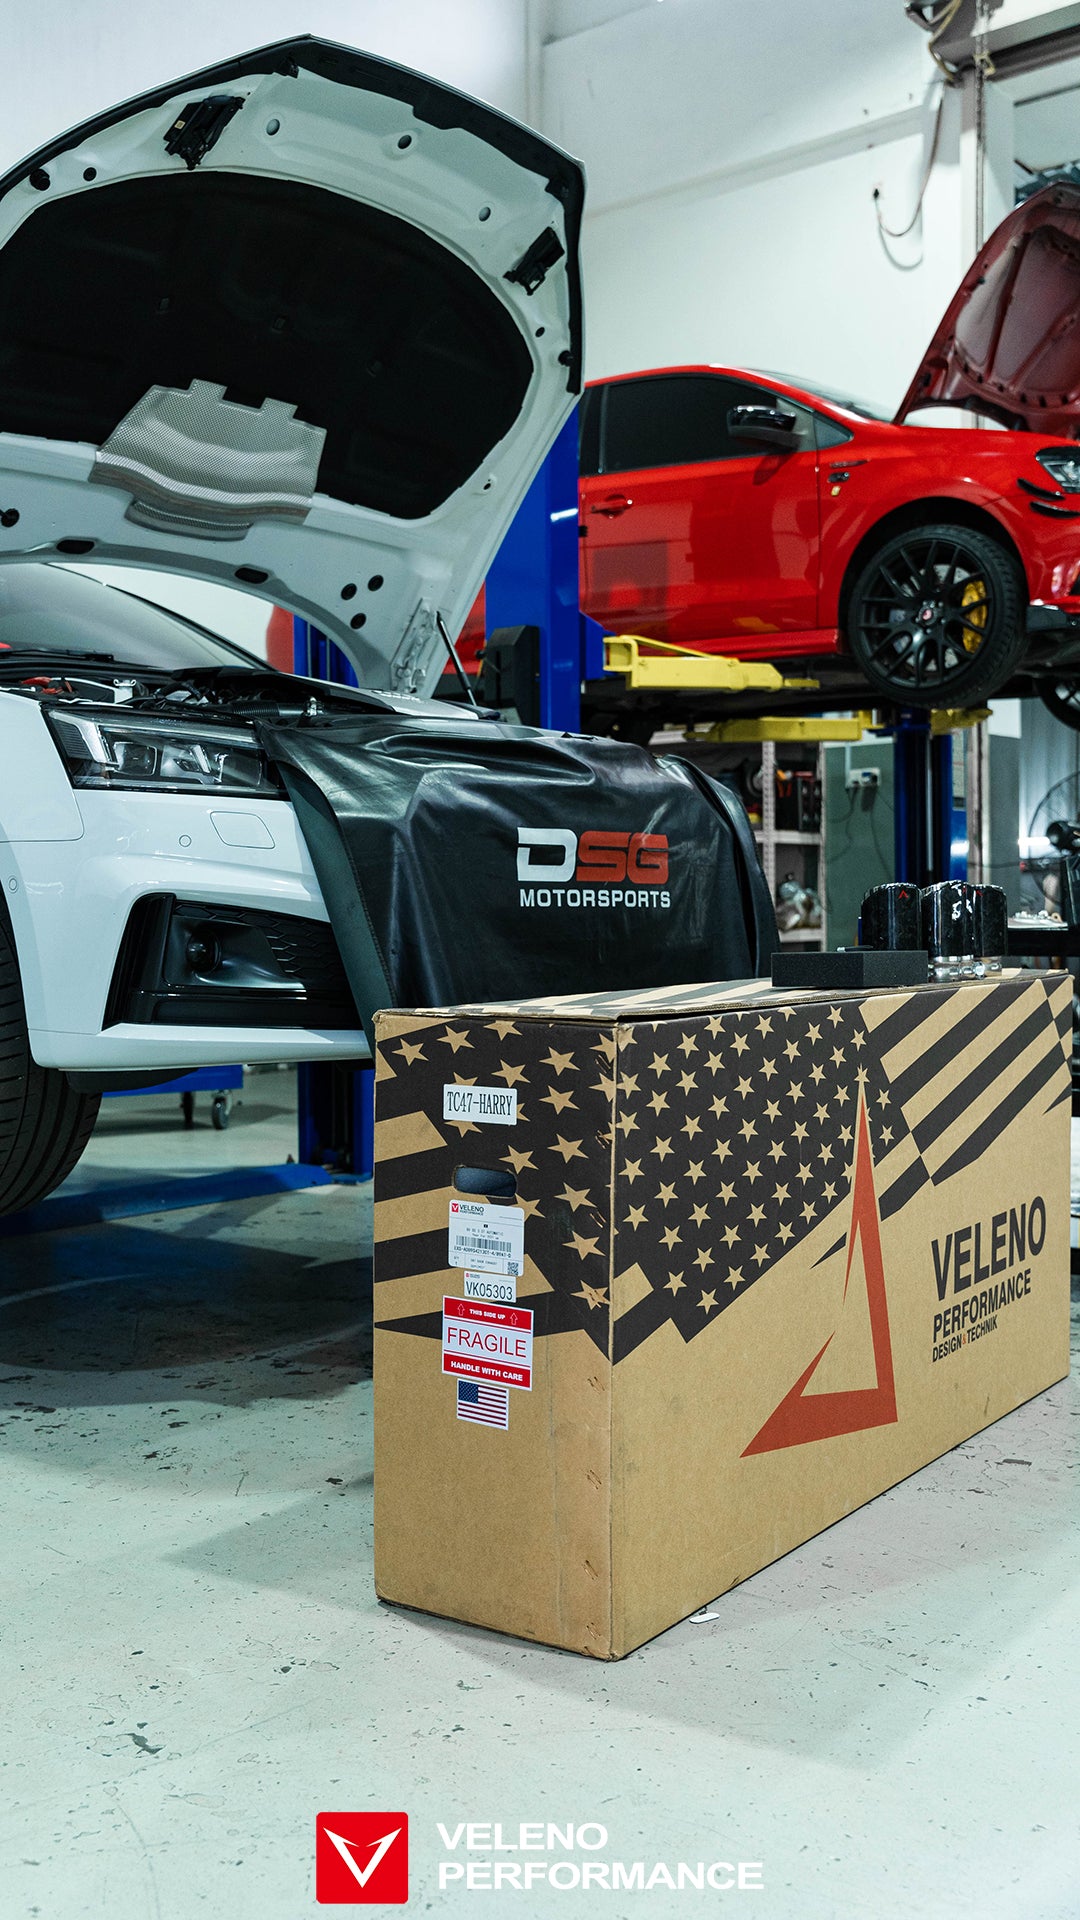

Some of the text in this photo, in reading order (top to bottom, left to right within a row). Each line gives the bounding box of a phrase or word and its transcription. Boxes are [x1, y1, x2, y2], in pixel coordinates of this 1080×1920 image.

[517, 827, 669, 885] DSG
[519, 889, 671, 908] MOTORSPORTS
[447, 1091, 513, 1115] TC47-HARRY
[459, 1204, 485, 1212] VELENO
[931, 1195, 1047, 1302] VELENO
[466, 1281, 513, 1300] VK05303
[469, 1308, 483, 1317] THIS
[483, 1311, 497, 1319] SIDE
[933, 1268, 1031, 1343] PERFORMANCE
[447, 1326, 527, 1358] FRAGILE
[450, 1360, 524, 1382] HANDLE WITH CARE
